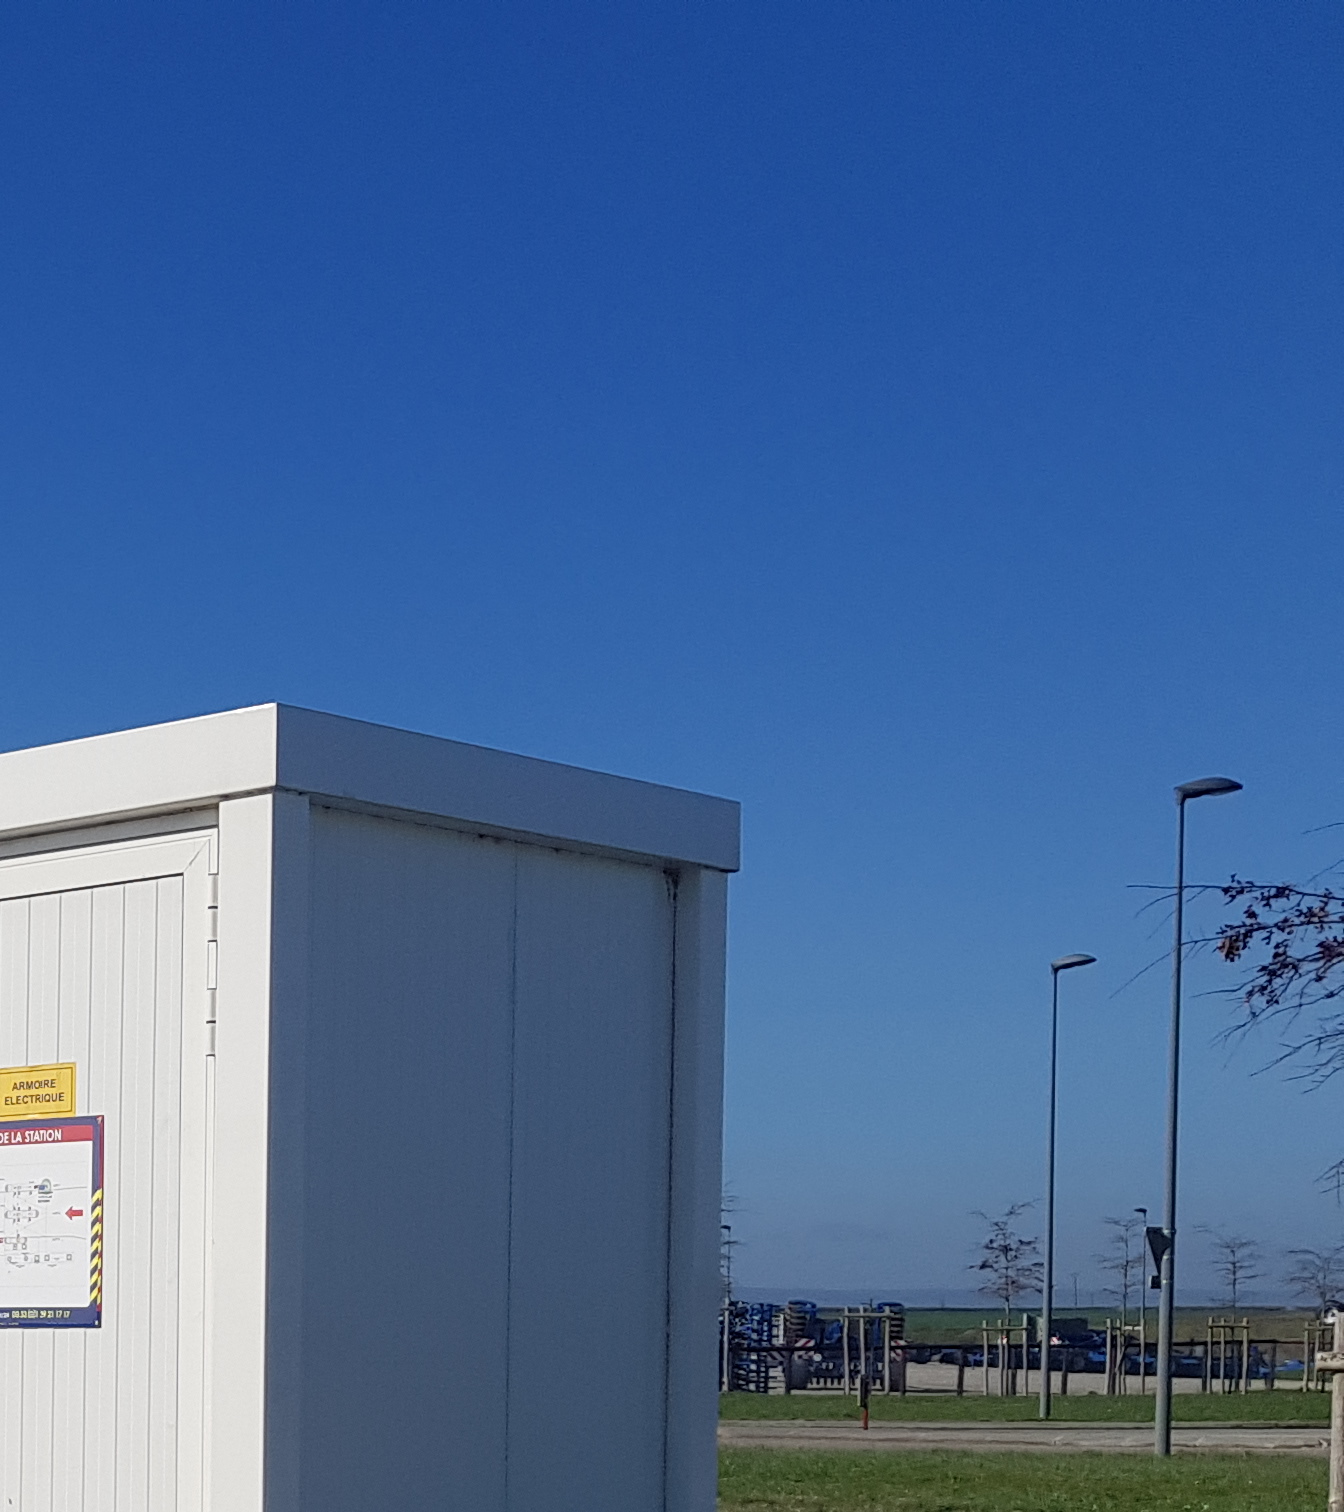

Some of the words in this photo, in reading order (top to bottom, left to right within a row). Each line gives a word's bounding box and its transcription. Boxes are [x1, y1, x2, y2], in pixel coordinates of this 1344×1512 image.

[12, 1079, 57, 1092] ARMOIRE
[4, 1092, 65, 1106] ELECTRIQUE
[11, 1131, 22, 1143] LA
[24, 1129, 62, 1142] STATION
